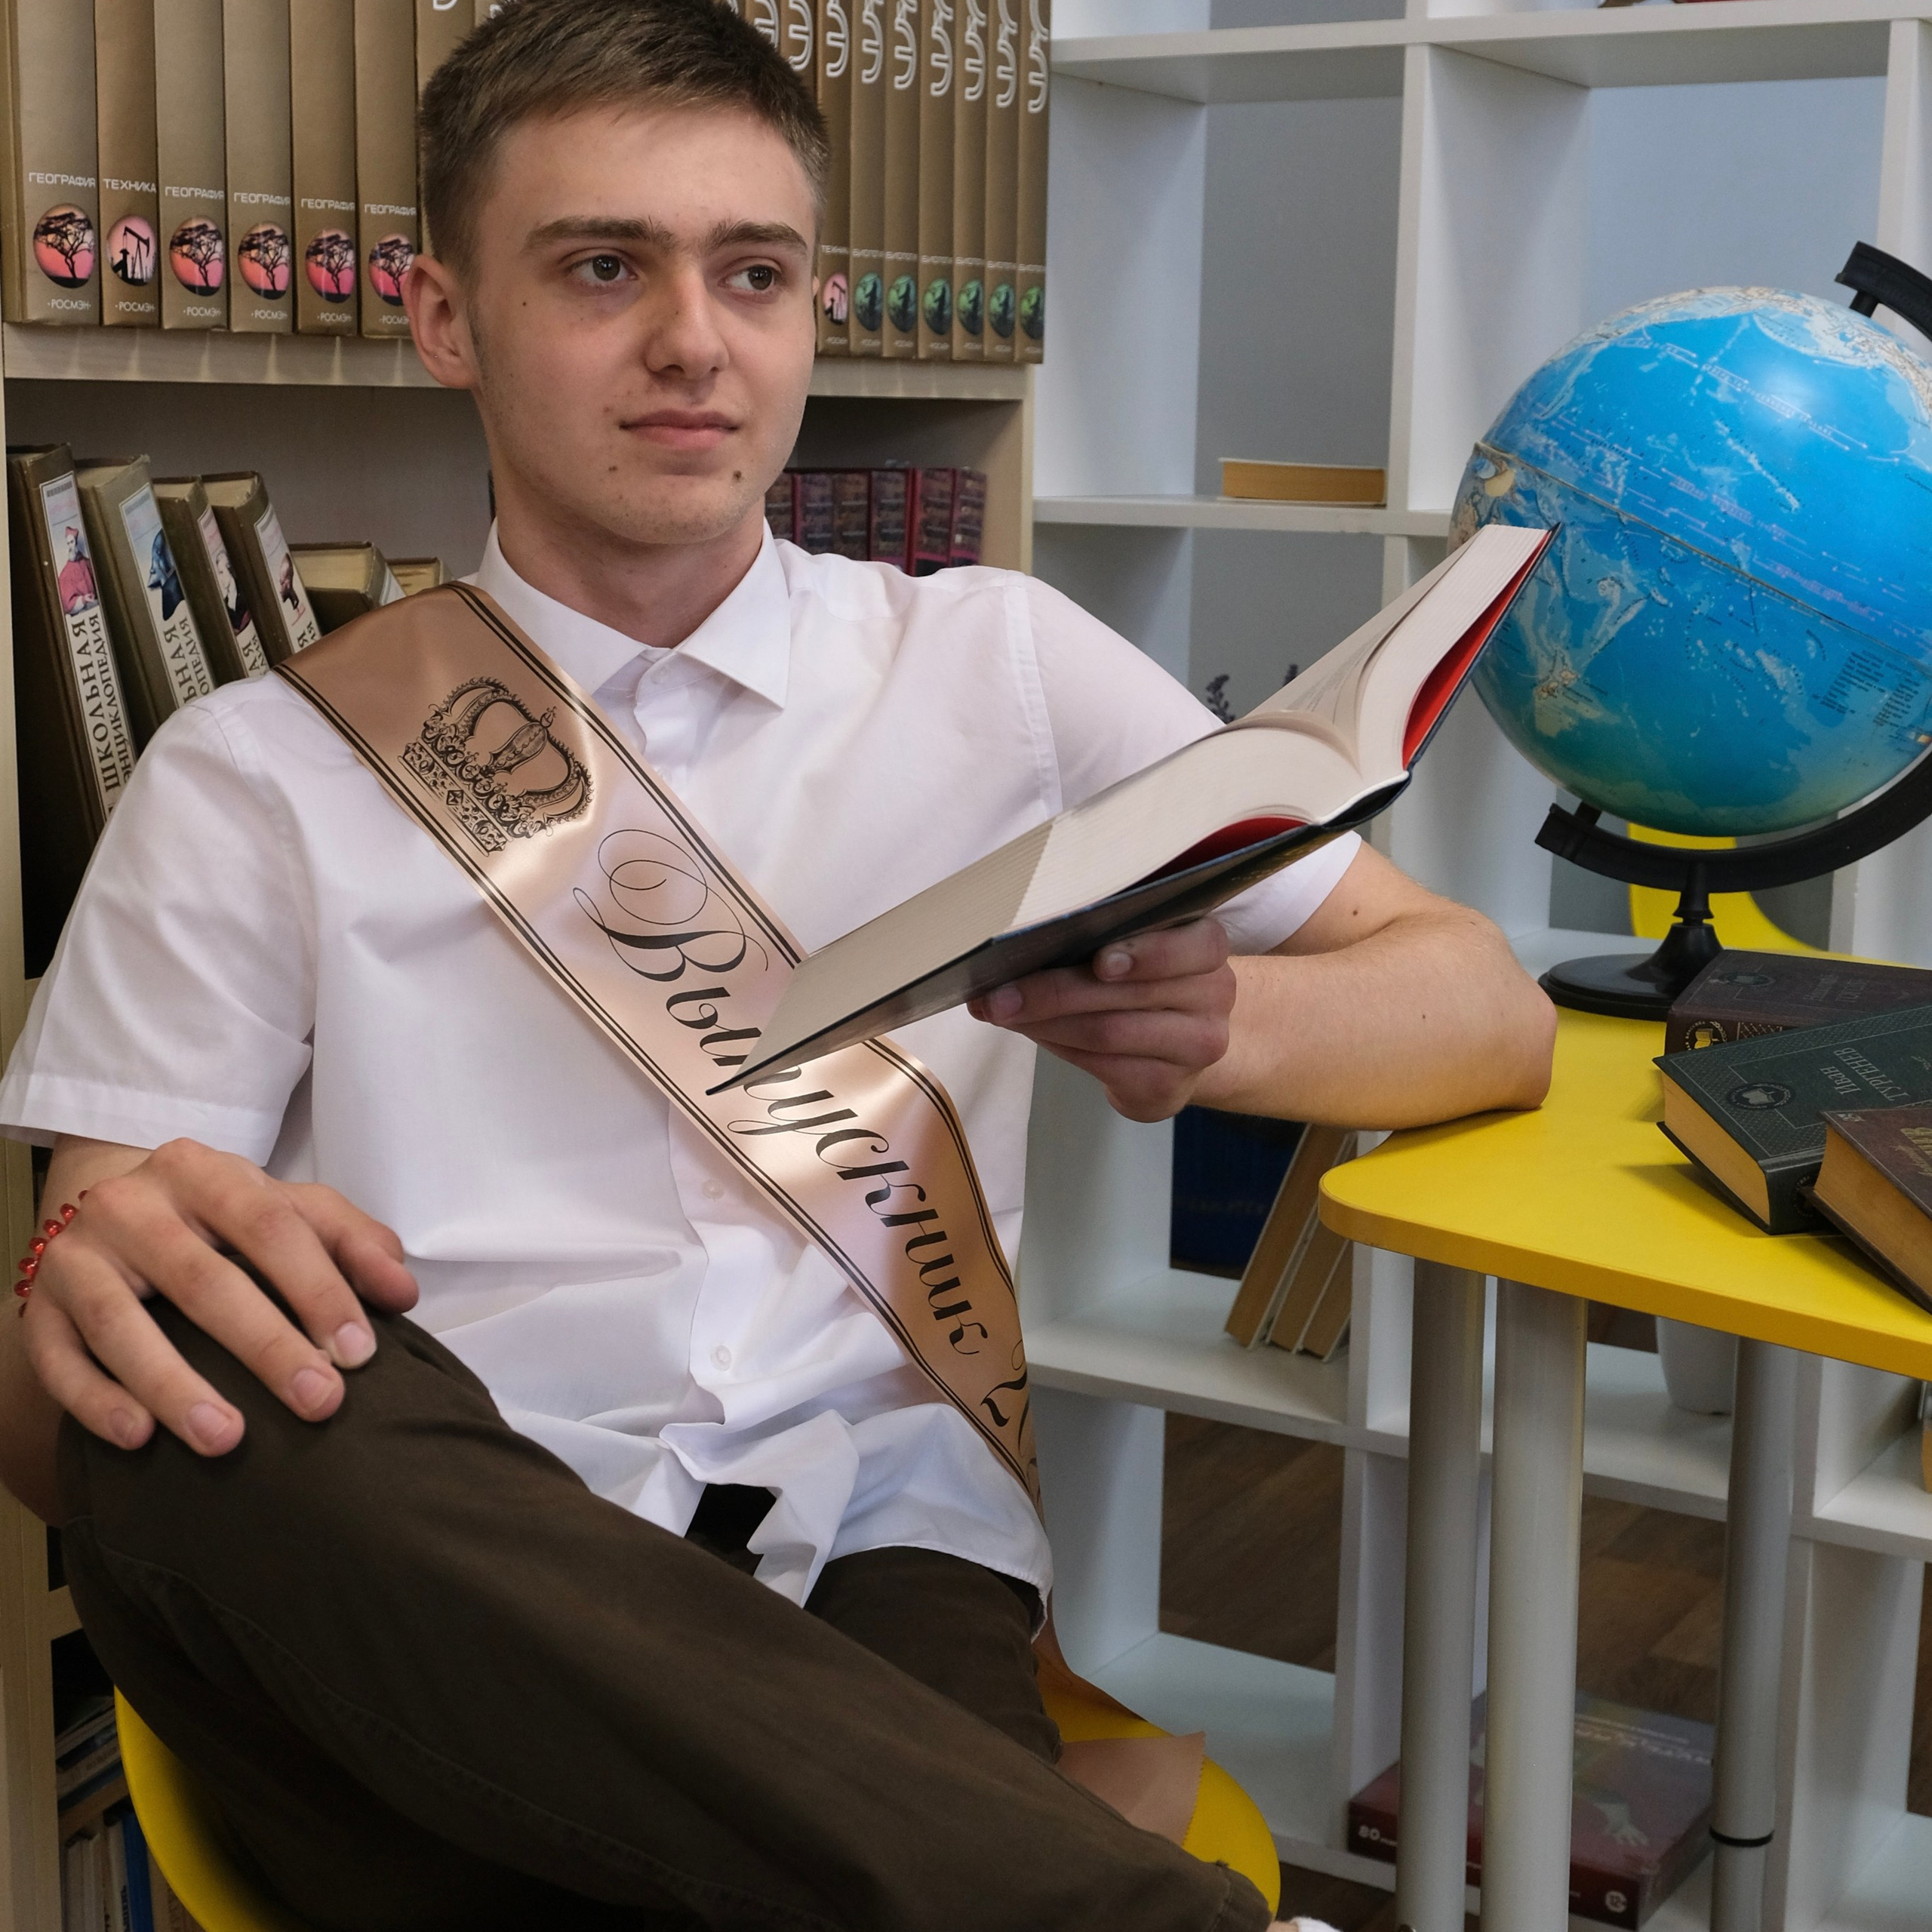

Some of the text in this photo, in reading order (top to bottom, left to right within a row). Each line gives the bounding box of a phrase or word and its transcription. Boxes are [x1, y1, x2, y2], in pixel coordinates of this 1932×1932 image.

[29, 172, 96, 188] ГЕОГРАФИЯ
[103, 178, 157, 193] ТЕХНИКА
[165, 186, 224, 200] ГЕОГРАФИЯ
[234, 192, 291, 205] ГЕОГРАФИЯ
[365, 204, 417, 216] ГЕОГРАФИЯ
[162, 625, 198, 704] ЬНАЯ
[179, 617, 211, 695] ОПЕДИЯ
[71, 619, 121, 792] ШКОЛЬНАЯ
[1819, 1066, 1862, 1095] Иван
[1833, 1047, 1909, 1101] ТУРГЕНЕВ
